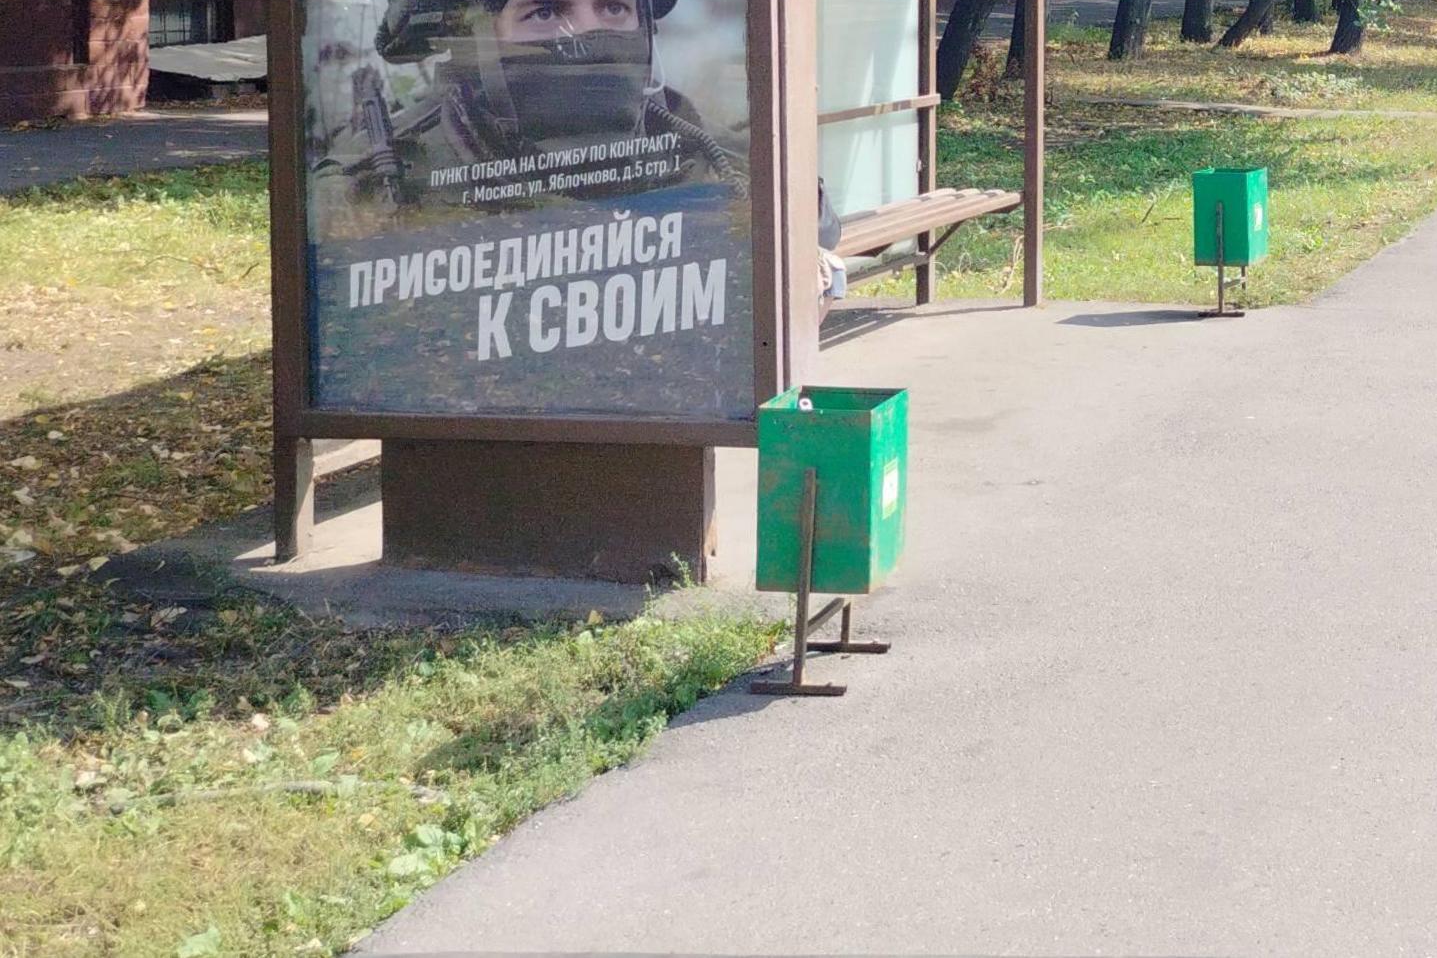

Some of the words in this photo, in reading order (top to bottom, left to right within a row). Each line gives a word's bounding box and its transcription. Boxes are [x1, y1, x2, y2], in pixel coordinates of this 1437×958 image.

[431, 166, 469, 187] ПУНКТ
[471, 159, 517, 181] ОТБОРА
[519, 156, 536, 173] НА
[537, 148, 586, 169] СЛУЖБУ
[589, 145, 606, 163] ПО
[609, 132, 682, 159] КОНТРАКТУ:
[463, 193, 471, 205] г.
[474, 182, 526, 203] Москва,
[528, 179, 546, 198] ул.
[549, 166, 621, 193] Яблочкова,
[645, 157, 671, 177] стр.
[673, 154, 681, 172] 1
[349, 209, 683, 308] ПРИСОЕДИНЯЙСЯ
[477, 292, 513, 361] К
[528, 258, 728, 355] СВОИМ
